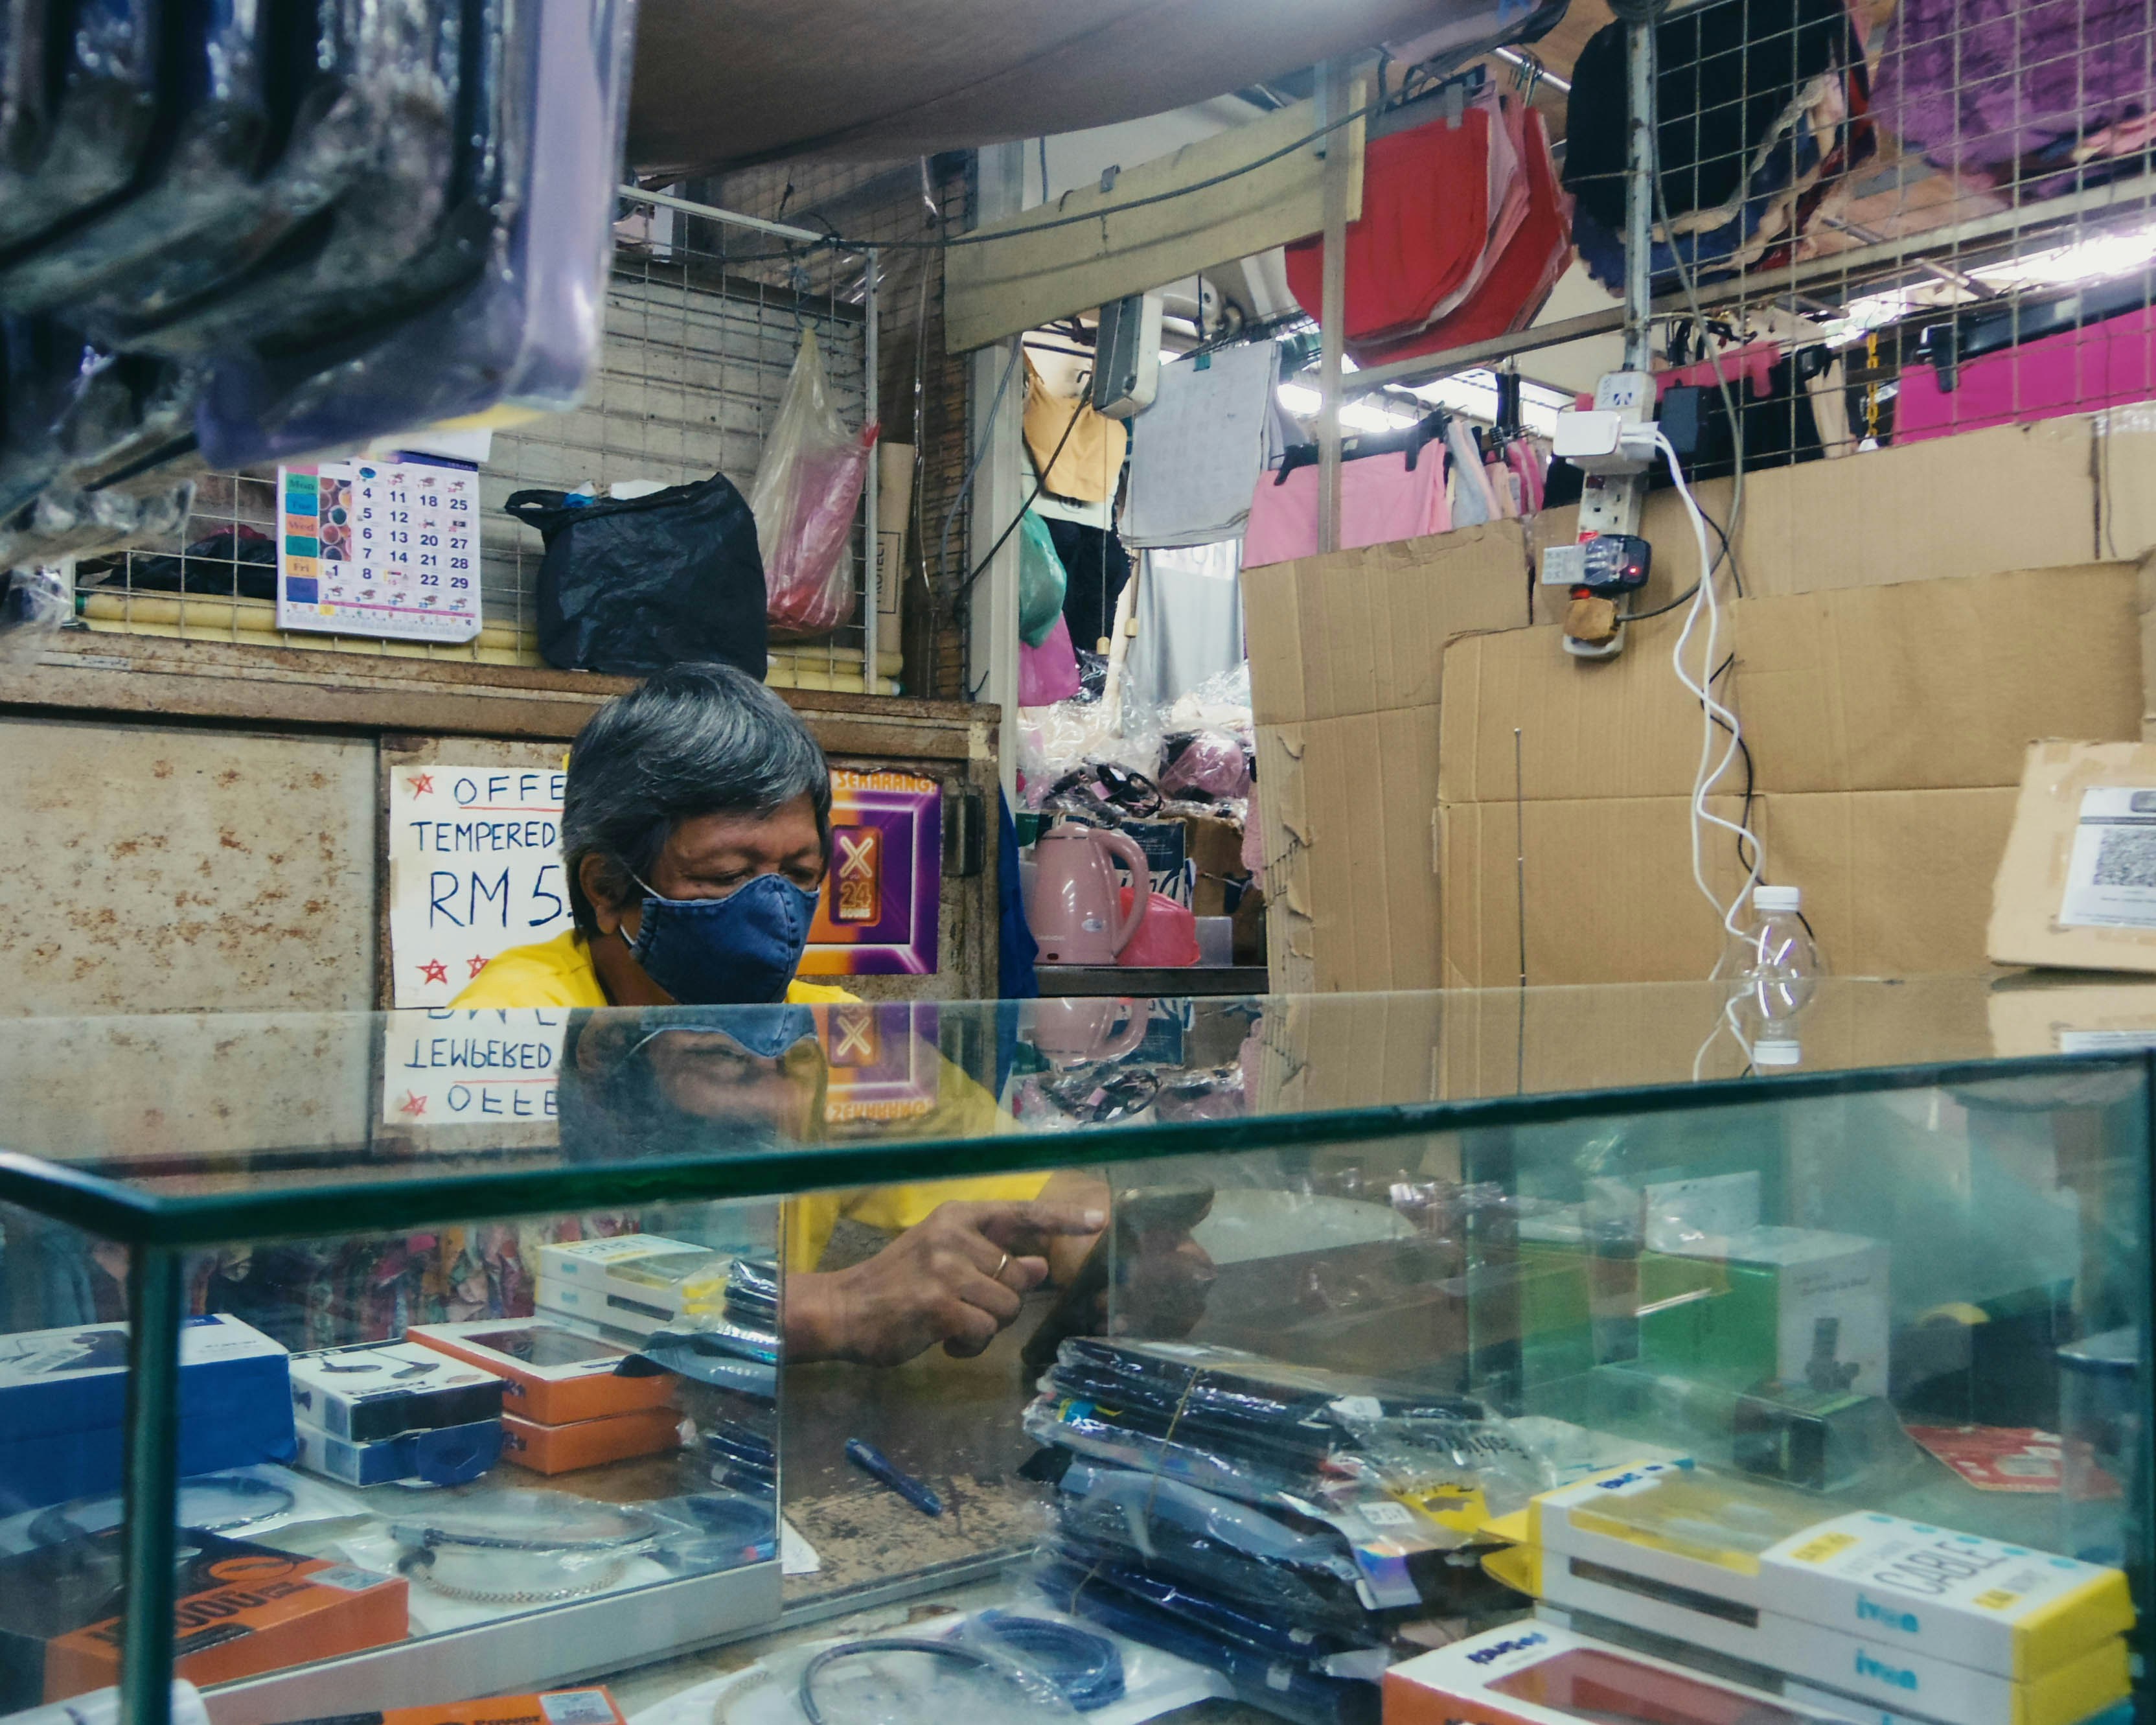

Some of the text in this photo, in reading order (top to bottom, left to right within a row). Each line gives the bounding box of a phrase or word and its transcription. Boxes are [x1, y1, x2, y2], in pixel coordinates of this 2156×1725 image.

[363, 487, 372, 498] 4
[390, 491, 406, 503] 11
[420, 495, 437, 507] 18
[450, 498, 468, 511] 25
[363, 507, 372, 518] 5
[390, 511, 408, 523] 12
[289, 520, 468, 549] Wed 6 13 20 27
[363, 548, 372, 559] 7
[390, 551, 408, 562] 14
[420, 554, 437, 566] 21
[450, 557, 468, 569] 28
[293, 562, 310, 572] Fri
[332, 564, 338, 576] 1
[363, 568, 372, 579] 8
[420, 574, 439, 586] 22
[450, 577, 468, 589] 29
[453, 774, 566, 805] OFFE
[409, 821, 556, 852] TEMPERED
[430, 866, 509, 929] RM
[1872, 1540, 2008, 1595] CABLE
